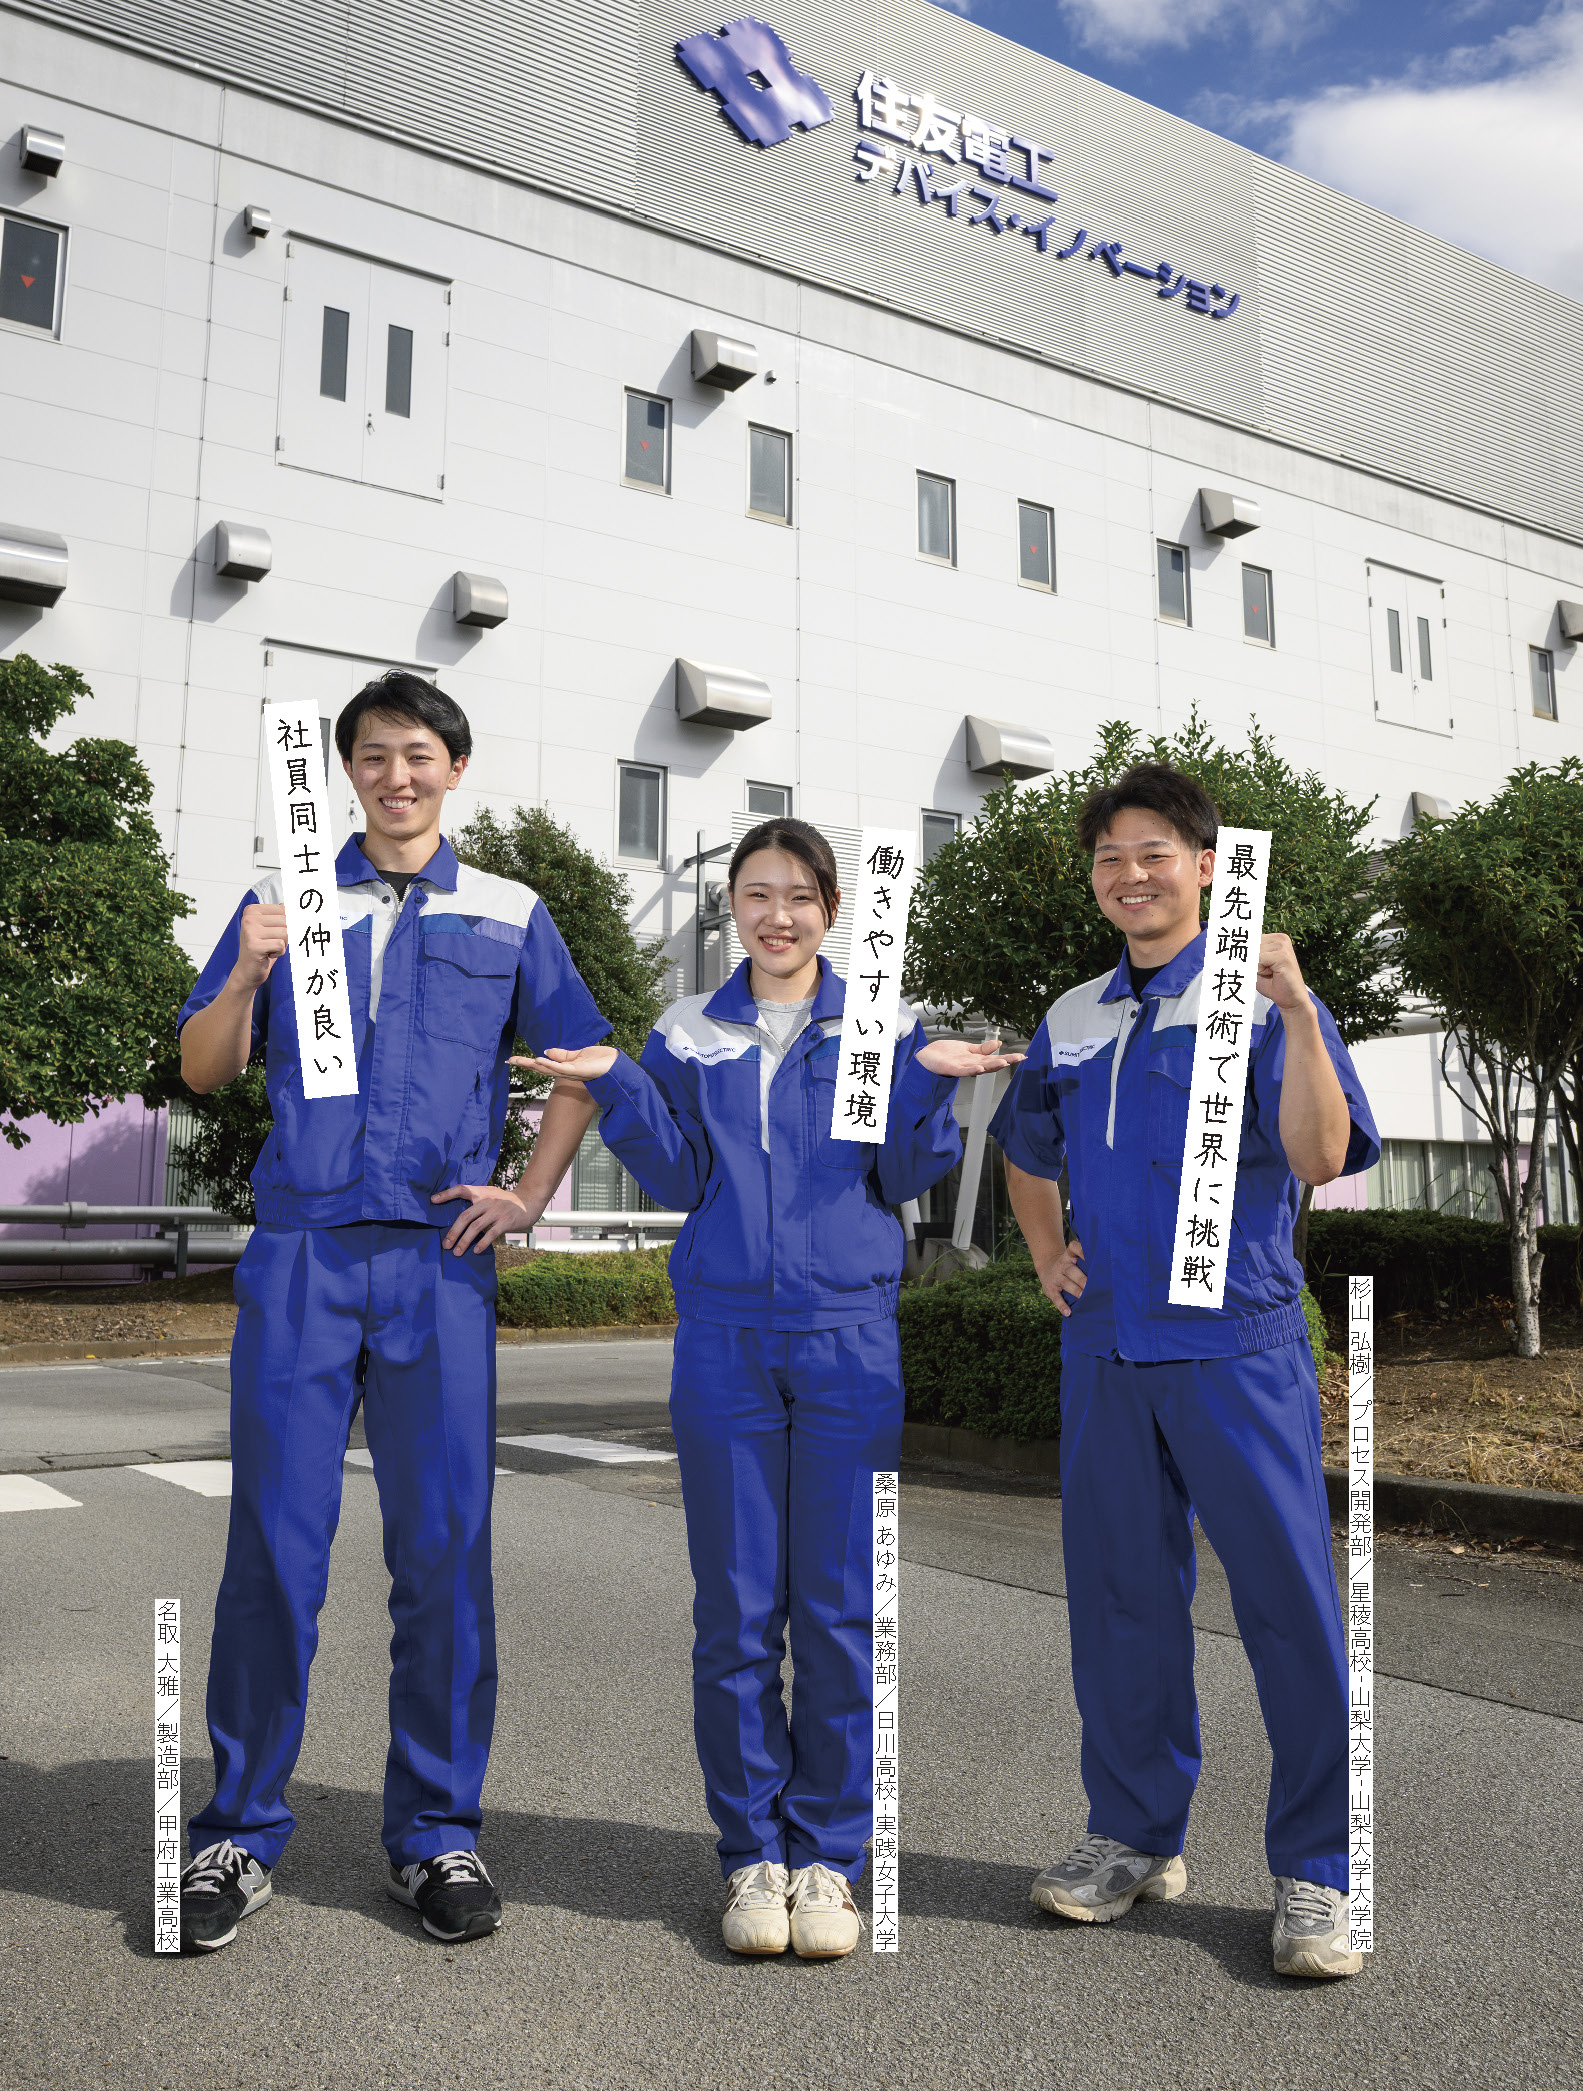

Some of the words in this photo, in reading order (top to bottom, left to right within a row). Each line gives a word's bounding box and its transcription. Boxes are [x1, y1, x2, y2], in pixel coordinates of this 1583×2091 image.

[856, 68, 1058, 202] 住友電工
[857, 140, 1241, 319] デバイス・イノベーション
